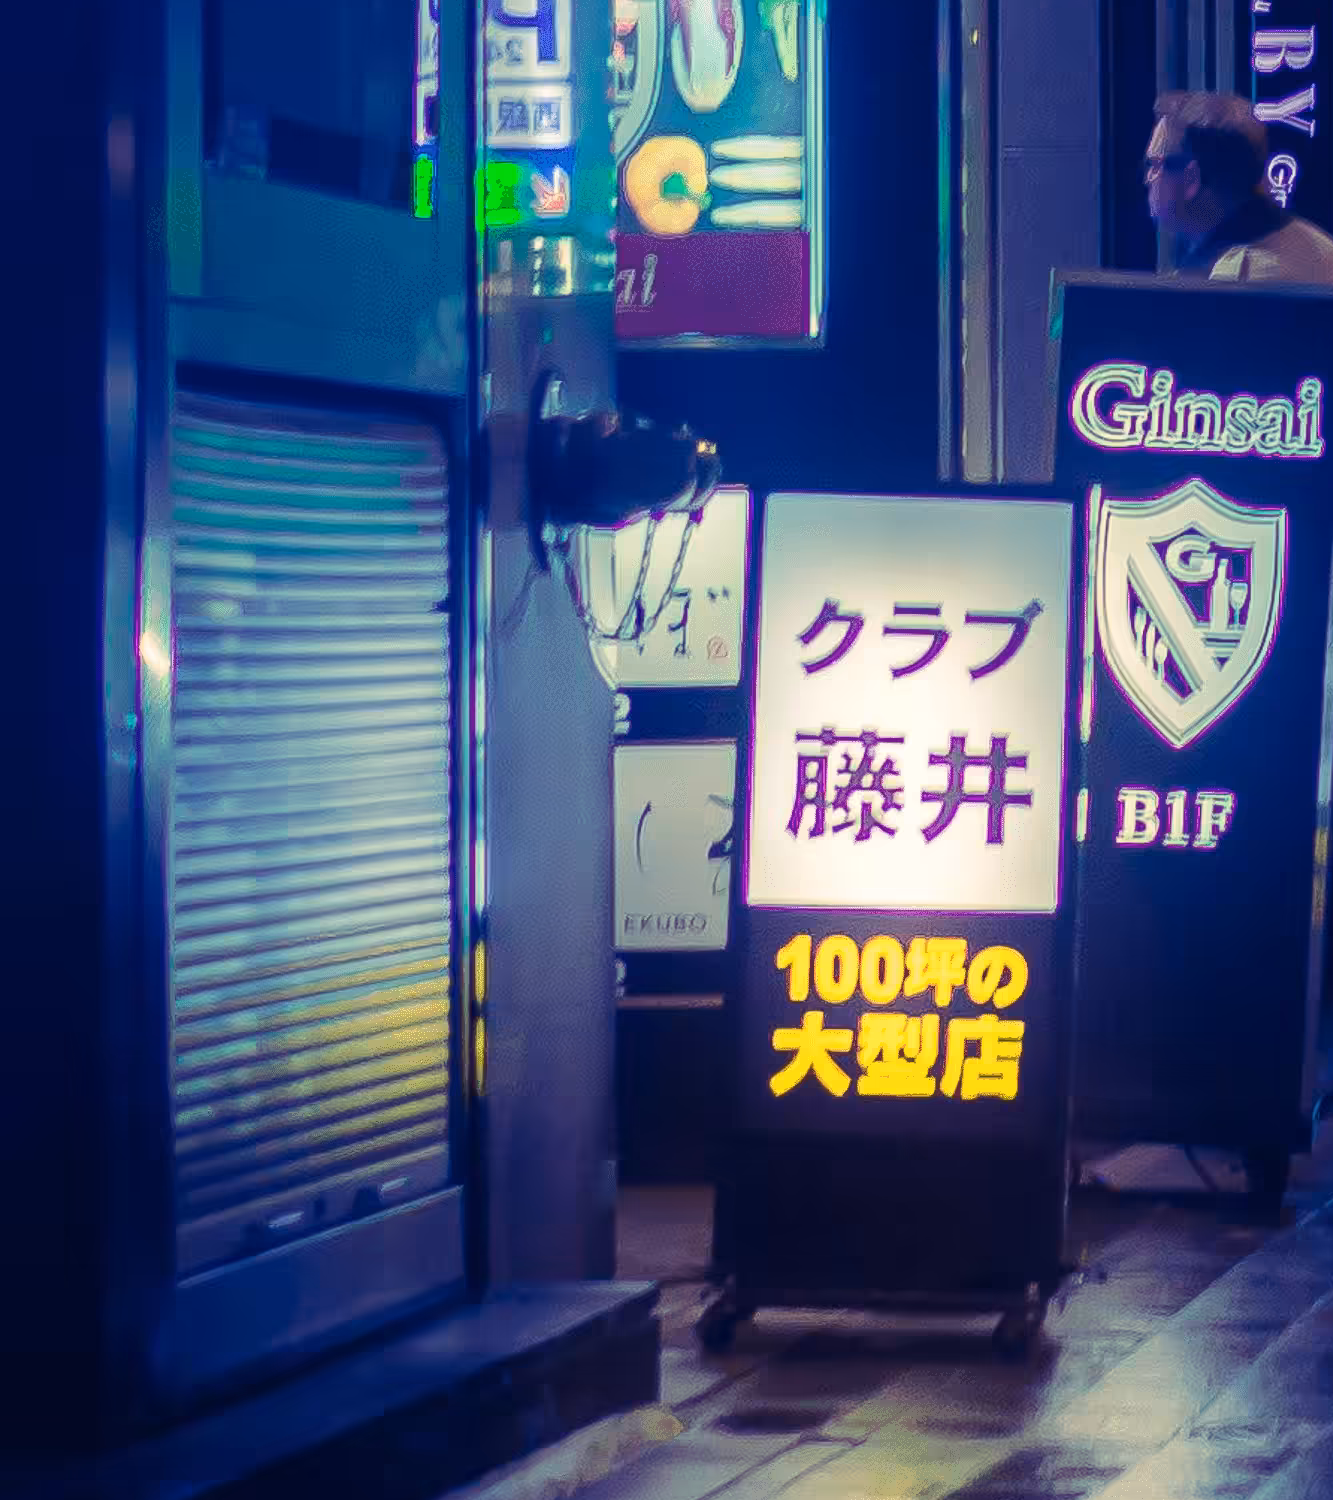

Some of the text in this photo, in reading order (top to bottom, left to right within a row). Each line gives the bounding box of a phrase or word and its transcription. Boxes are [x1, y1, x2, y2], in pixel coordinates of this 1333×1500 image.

[1071, 363, 1325, 458] Ginsai
[785, 726, 1034, 845] 藤井
[775, 933, 1030, 1010] 100坪の
[768, 1010, 1027, 1101] 大型店
